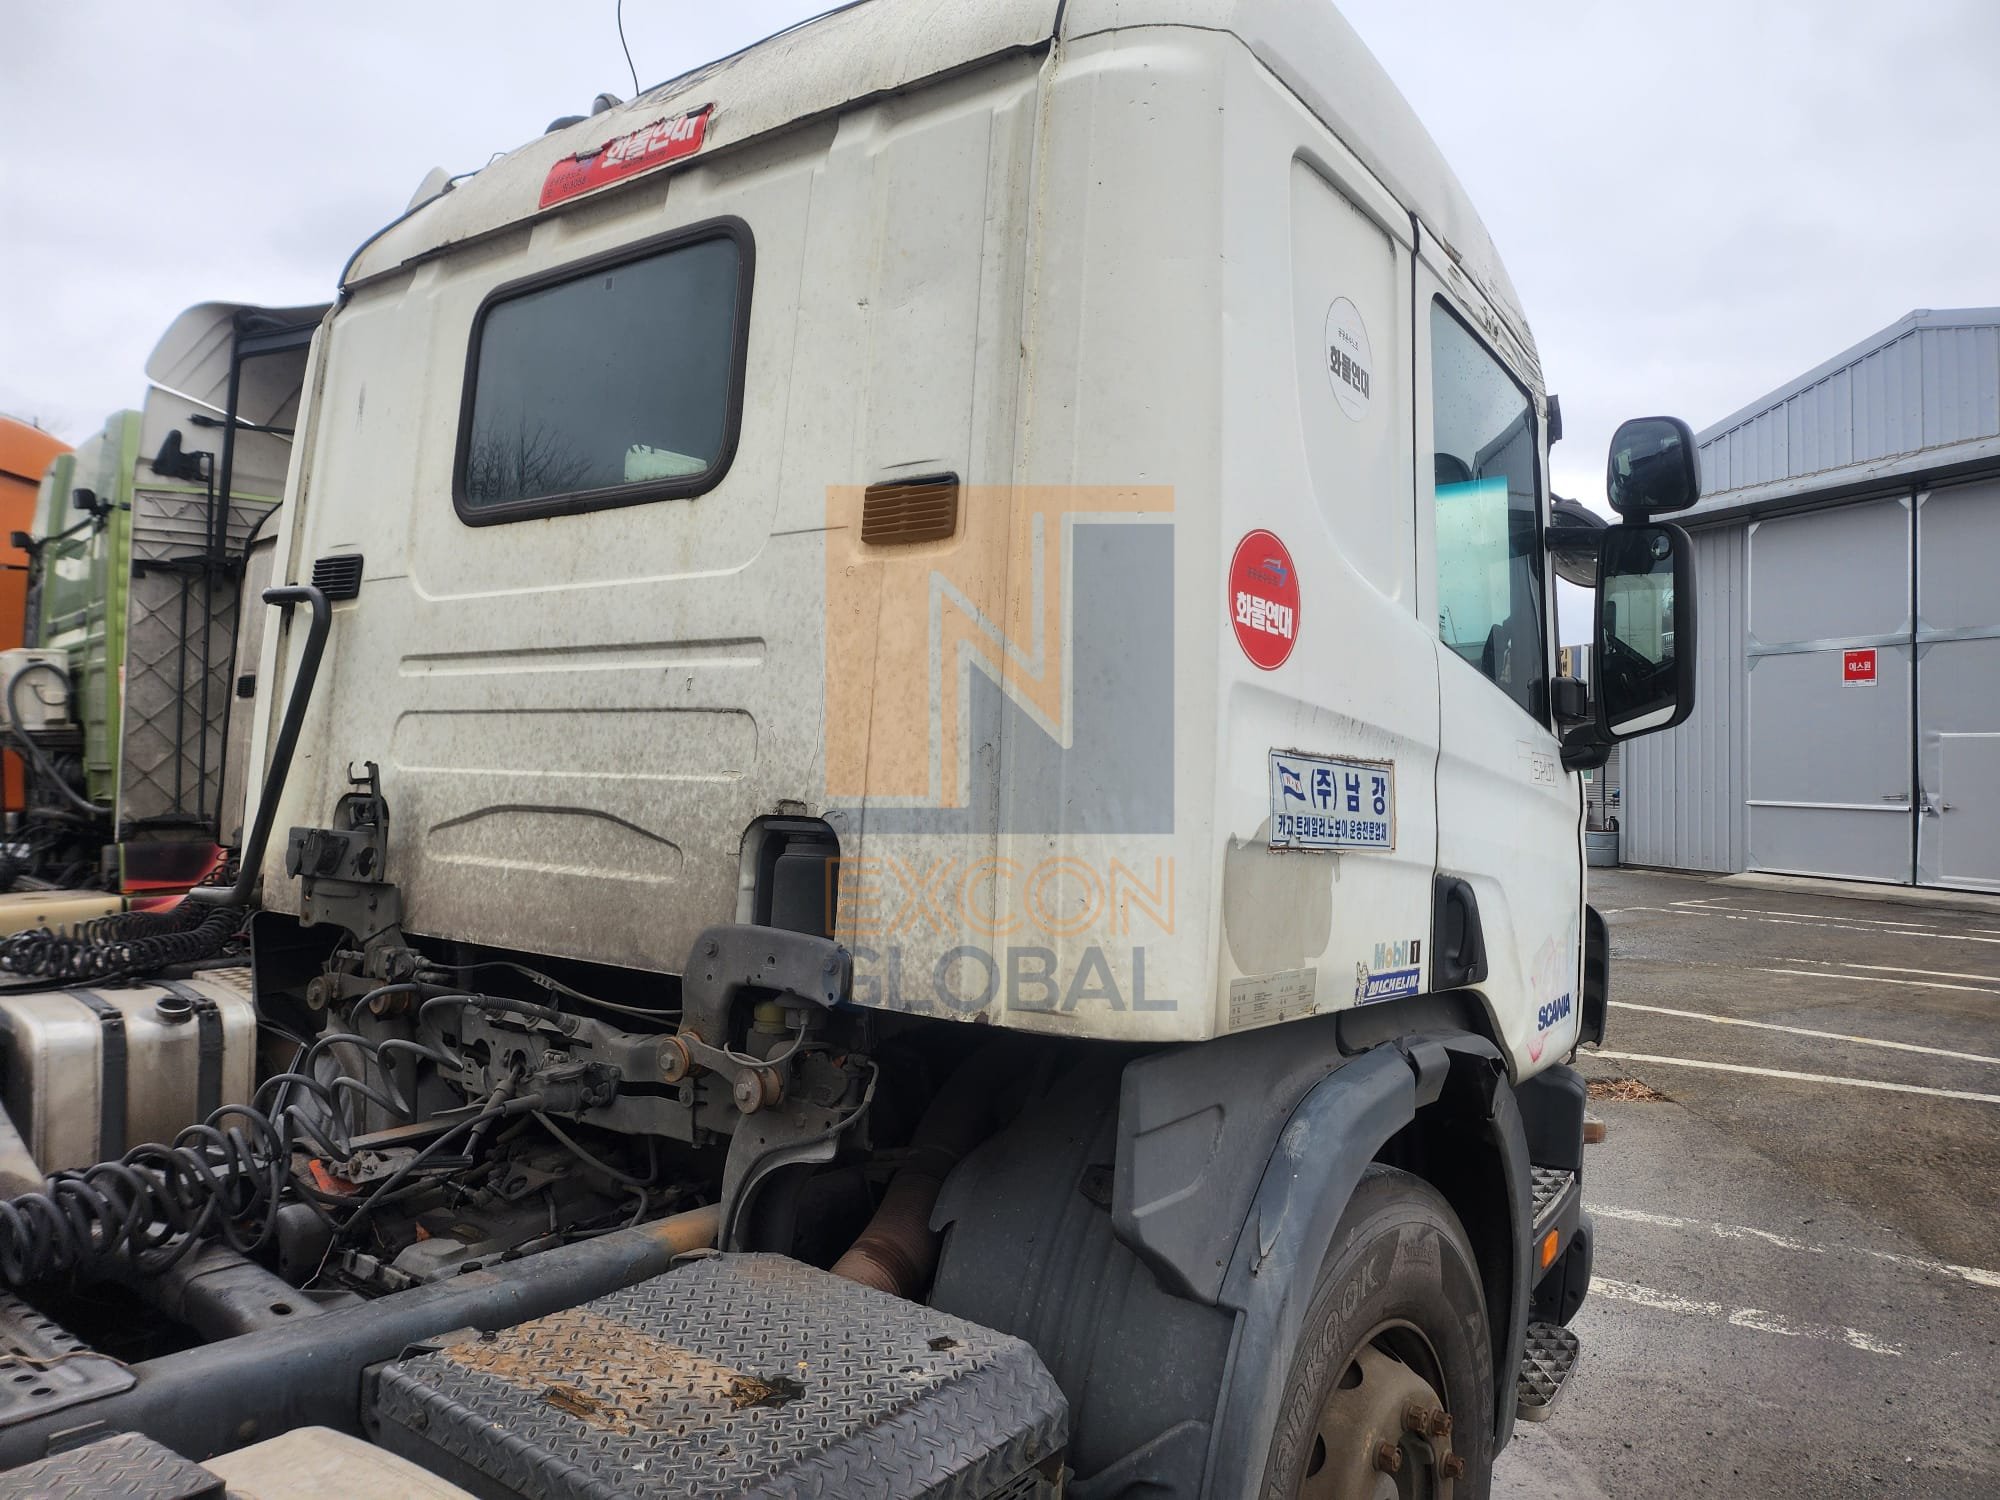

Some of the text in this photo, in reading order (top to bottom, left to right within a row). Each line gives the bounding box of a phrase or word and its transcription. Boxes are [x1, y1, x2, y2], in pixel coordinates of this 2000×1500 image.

[1330, 346, 1369, 400] 화물연대
[1237, 591, 1292, 639] 화물연대
[1848, 660, 1871, 671] 에스원
[1374, 940, 1408, 969] Mobil
[1368, 974, 1418, 996] MICHELIN
[1538, 993, 1570, 1031] SCANIA
